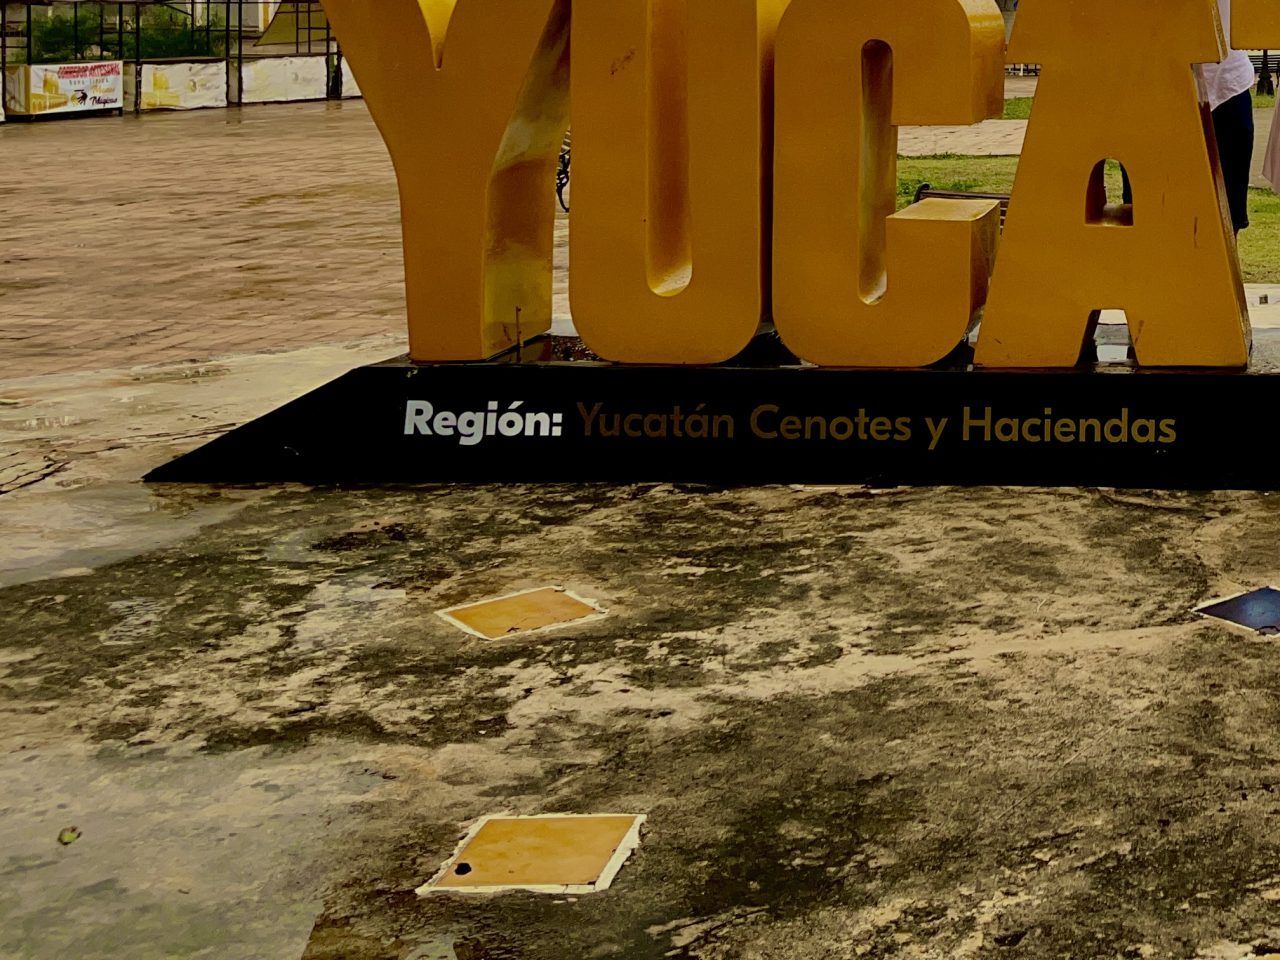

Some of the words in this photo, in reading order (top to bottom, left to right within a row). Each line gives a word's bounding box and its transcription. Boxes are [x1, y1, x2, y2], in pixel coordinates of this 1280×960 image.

[403, 399, 563, 446] Región:
[575, 402, 734, 439] Yucatán
[749, 403, 912, 442] Cenotes
[924, 416, 949, 451] y
[962, 406, 1177, 444] Haciendas
